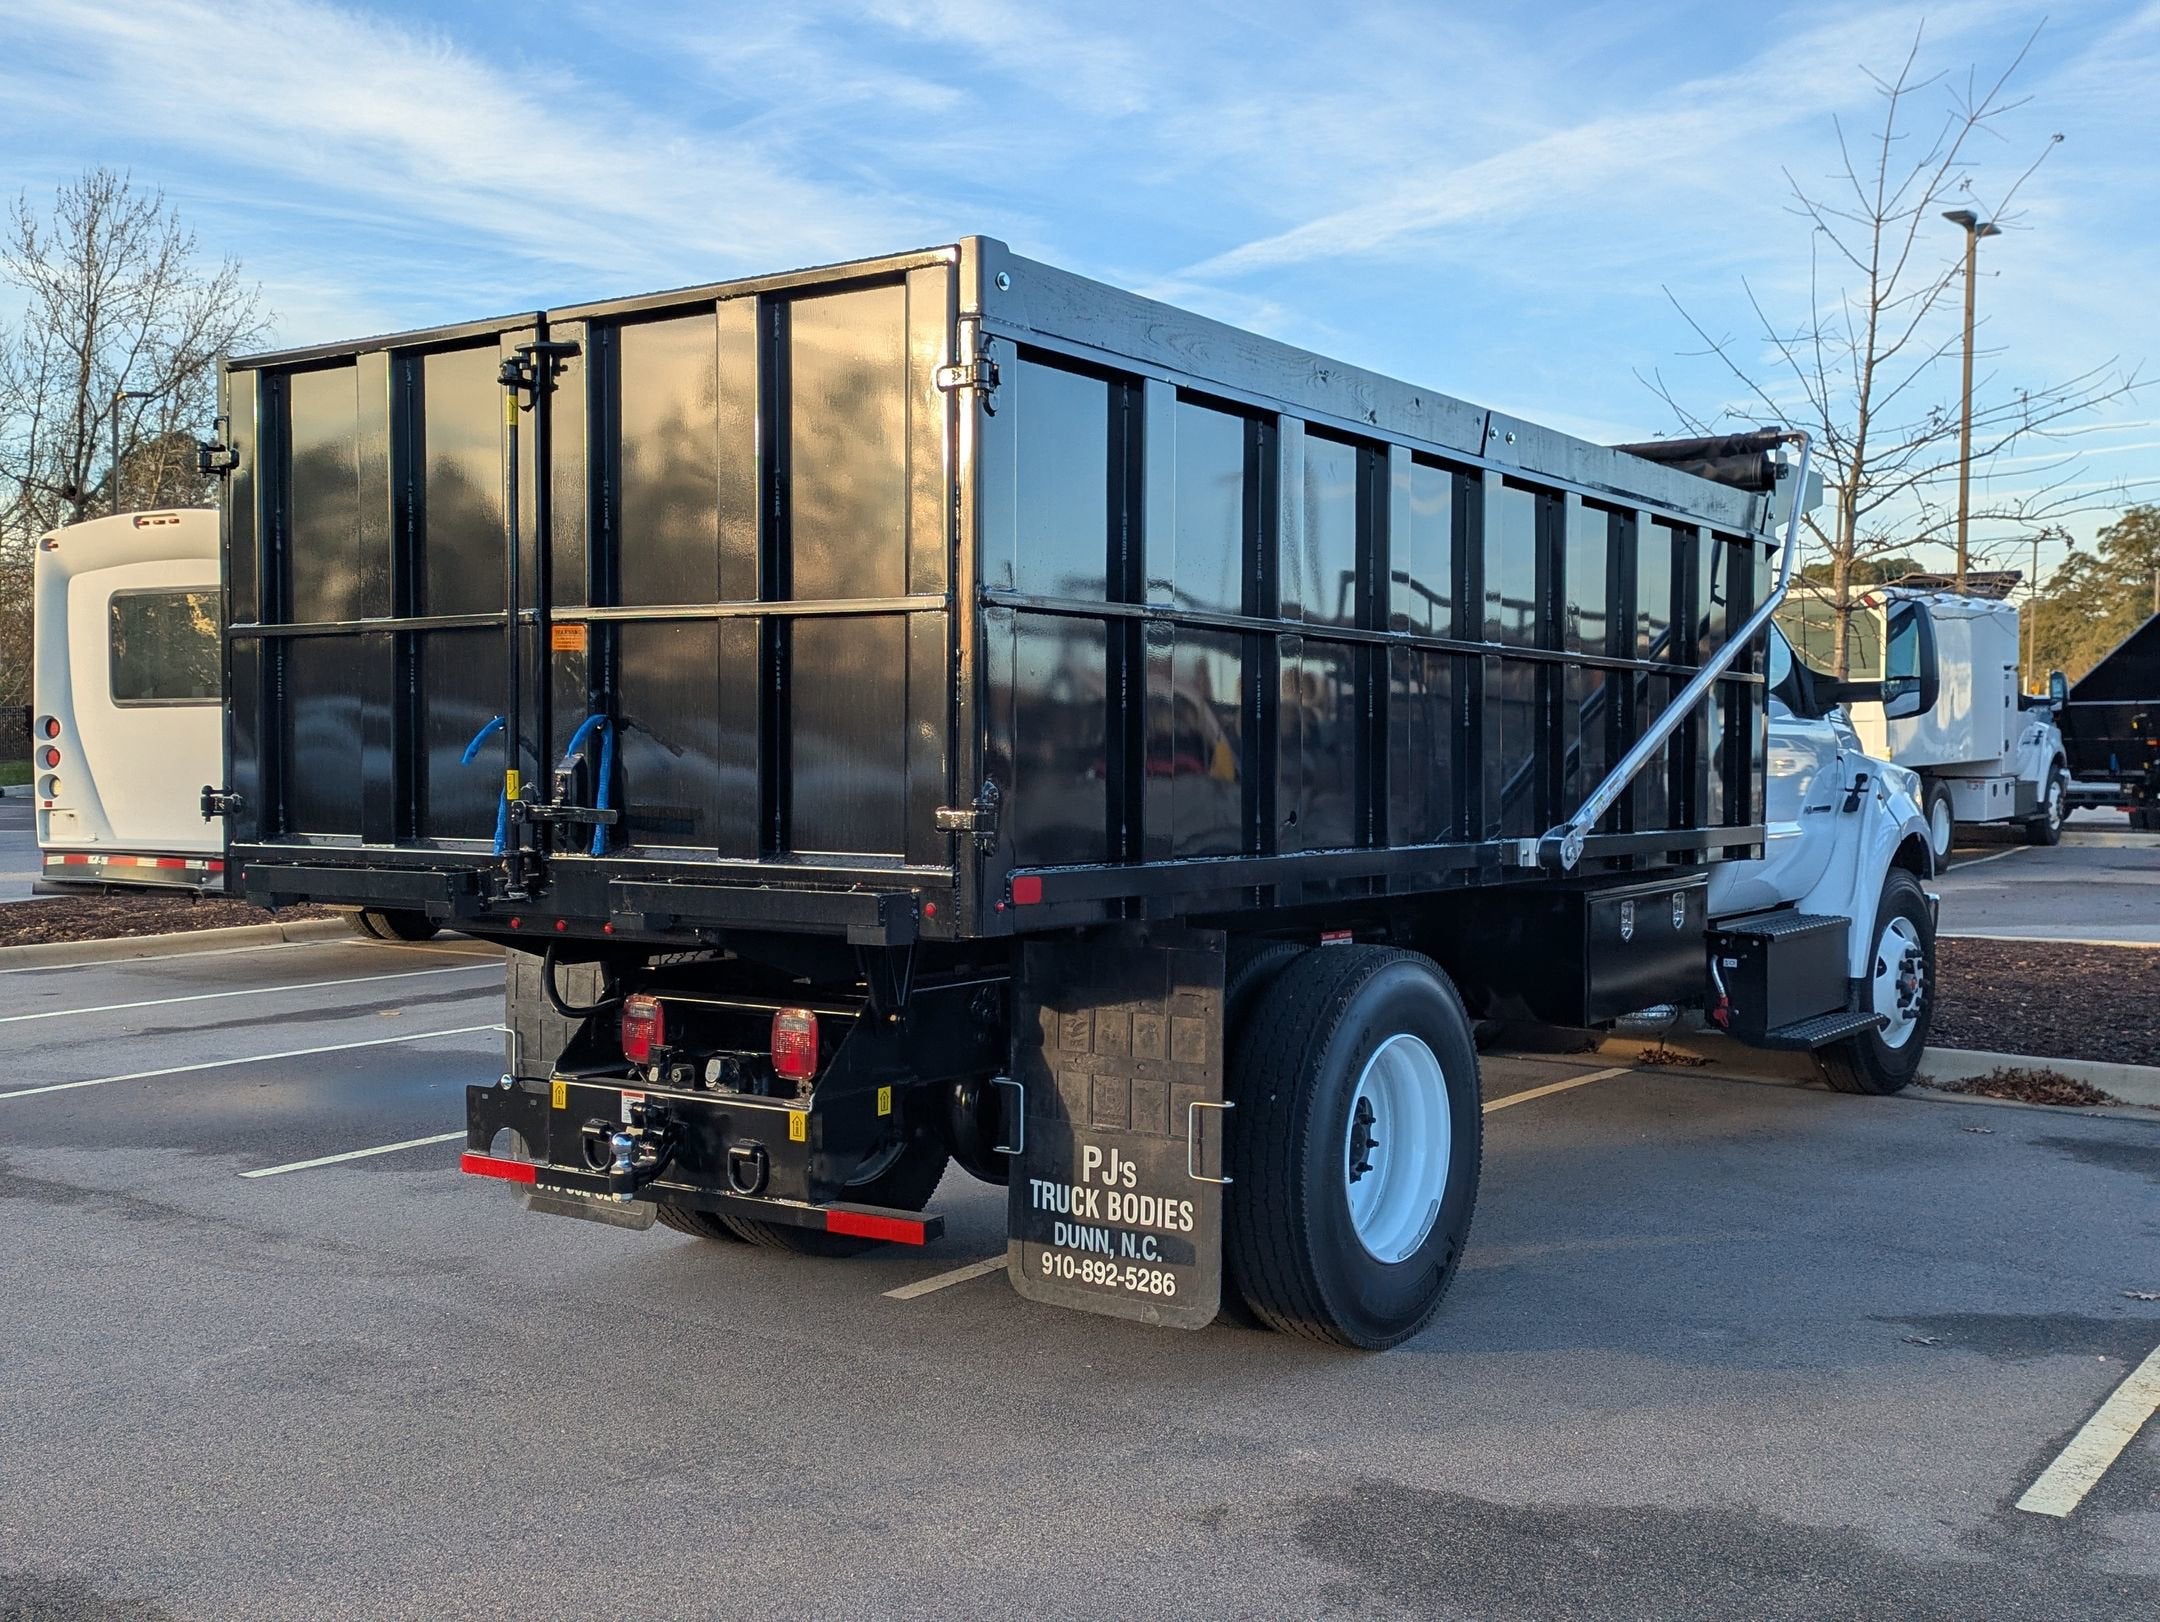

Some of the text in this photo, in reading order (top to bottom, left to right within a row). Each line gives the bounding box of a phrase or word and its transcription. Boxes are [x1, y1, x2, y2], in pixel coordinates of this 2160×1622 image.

[1030, 1179, 1194, 1232] TRUCK BODIES
[1054, 1221, 1163, 1262] DUNN, N.C.
[1041, 1251, 1176, 1296] 910-892-5286
